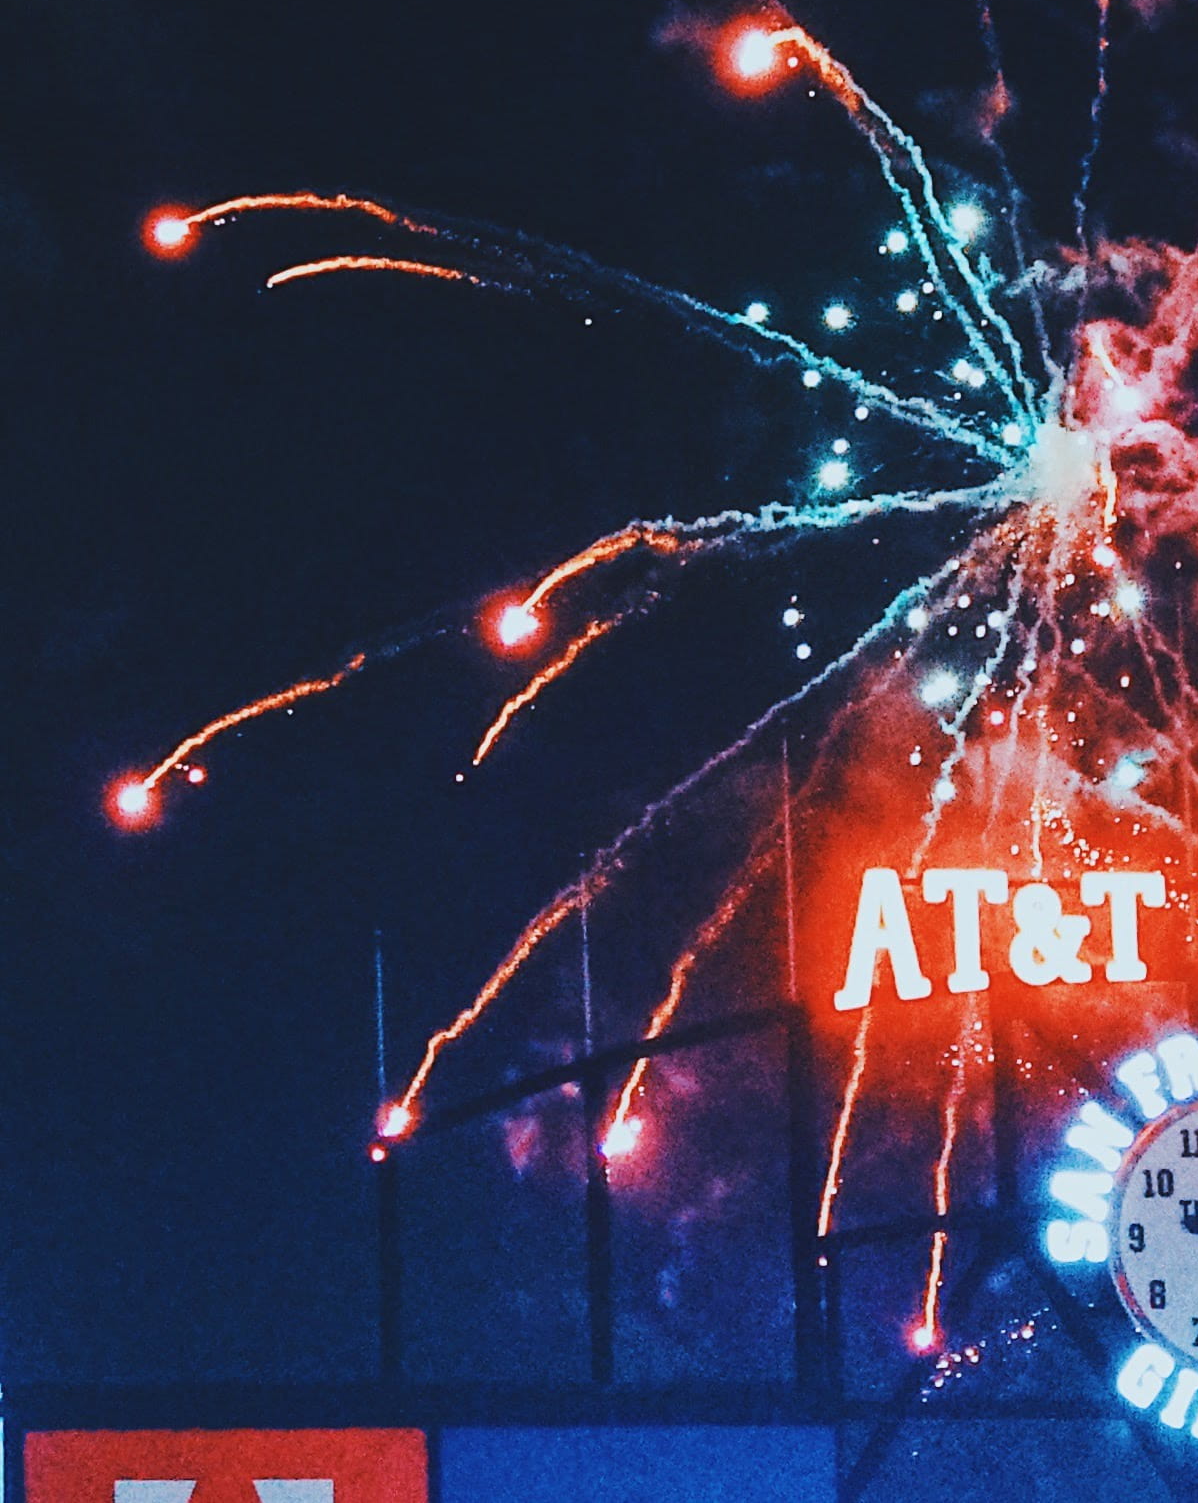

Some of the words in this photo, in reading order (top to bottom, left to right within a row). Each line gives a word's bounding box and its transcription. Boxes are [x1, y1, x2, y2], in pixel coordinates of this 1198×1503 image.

[833, 868, 1166, 1011] AT&T
[1047, 1100, 1134, 1263] SAN
[1143, 1168, 1175, 1197] 10
[1129, 1223, 1145, 1253] 9
[1149, 1279, 1166, 1309] 8
